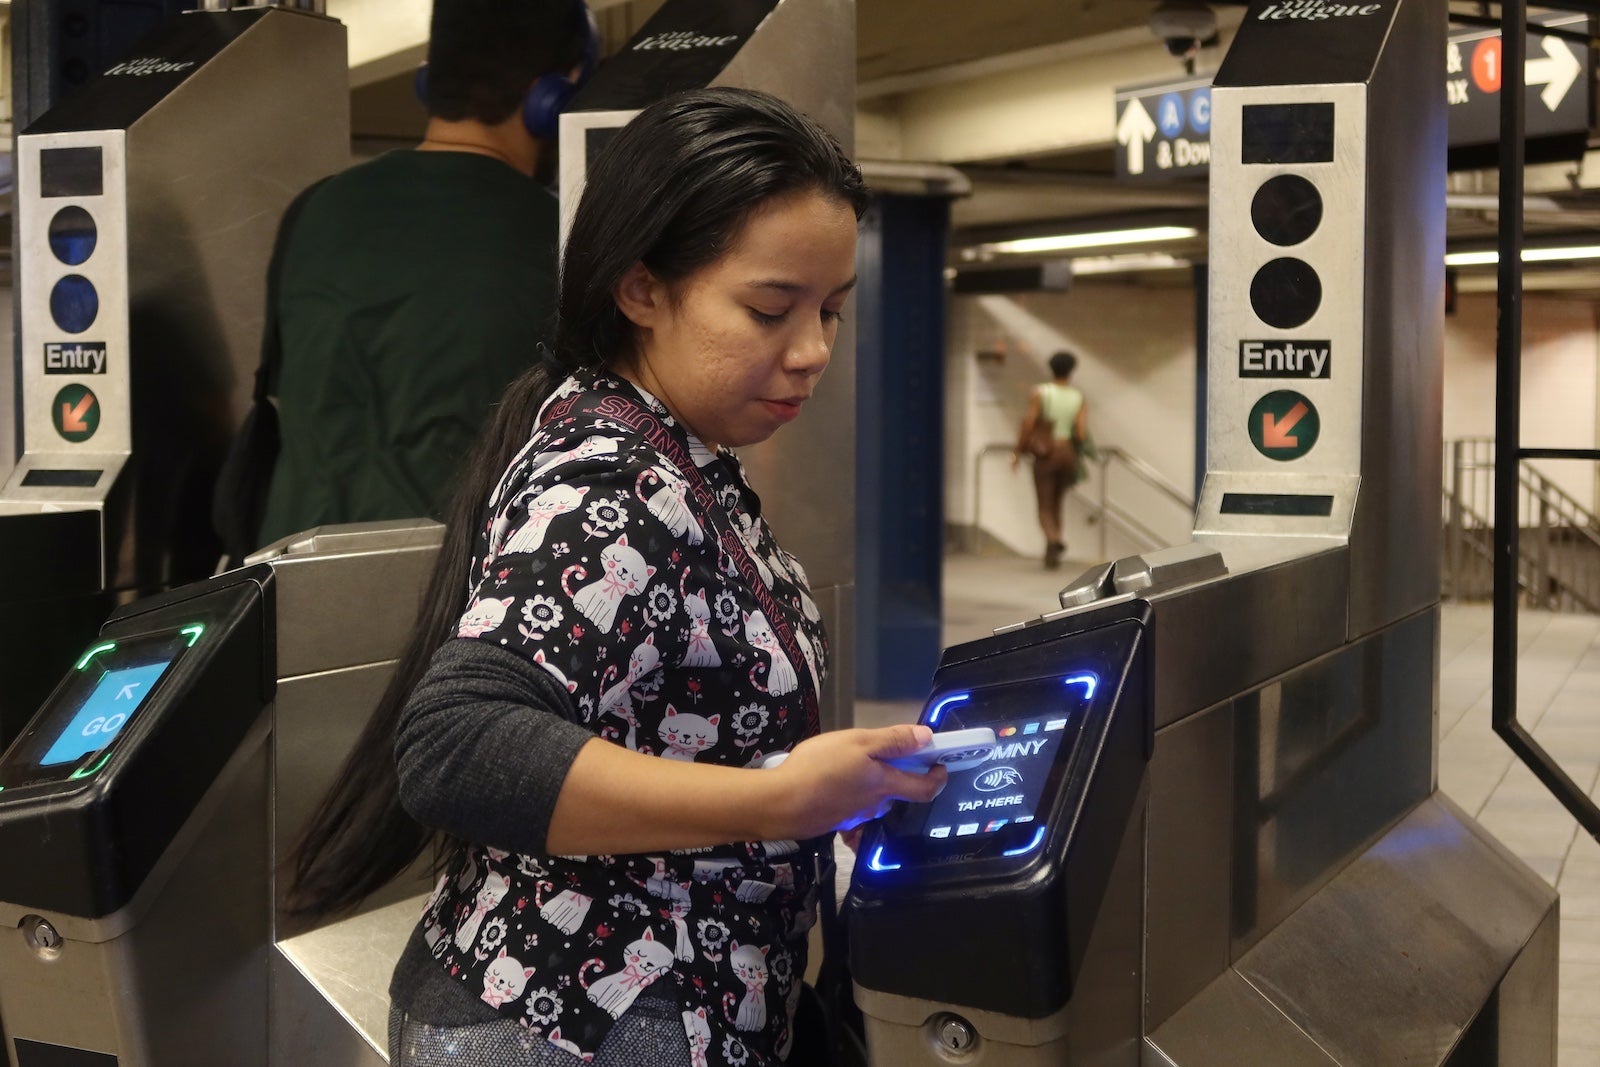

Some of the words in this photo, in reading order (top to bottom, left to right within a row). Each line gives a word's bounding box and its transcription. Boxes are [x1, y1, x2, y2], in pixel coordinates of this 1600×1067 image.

[1258, 4, 1381, 20] league
[1483, 49, 1496, 80] 1
[1162, 100, 1180, 130] A
[1192, 95, 1210, 125] C
[1156, 140, 1173, 169] &
[46, 345, 105, 374] Entry
[1243, 343, 1329, 377] Entry
[594, 395, 714, 512] PEANUTS
[82, 713, 125, 736] GO
[957, 800, 983, 812] TAP
[985, 795, 1024, 808] HERE
